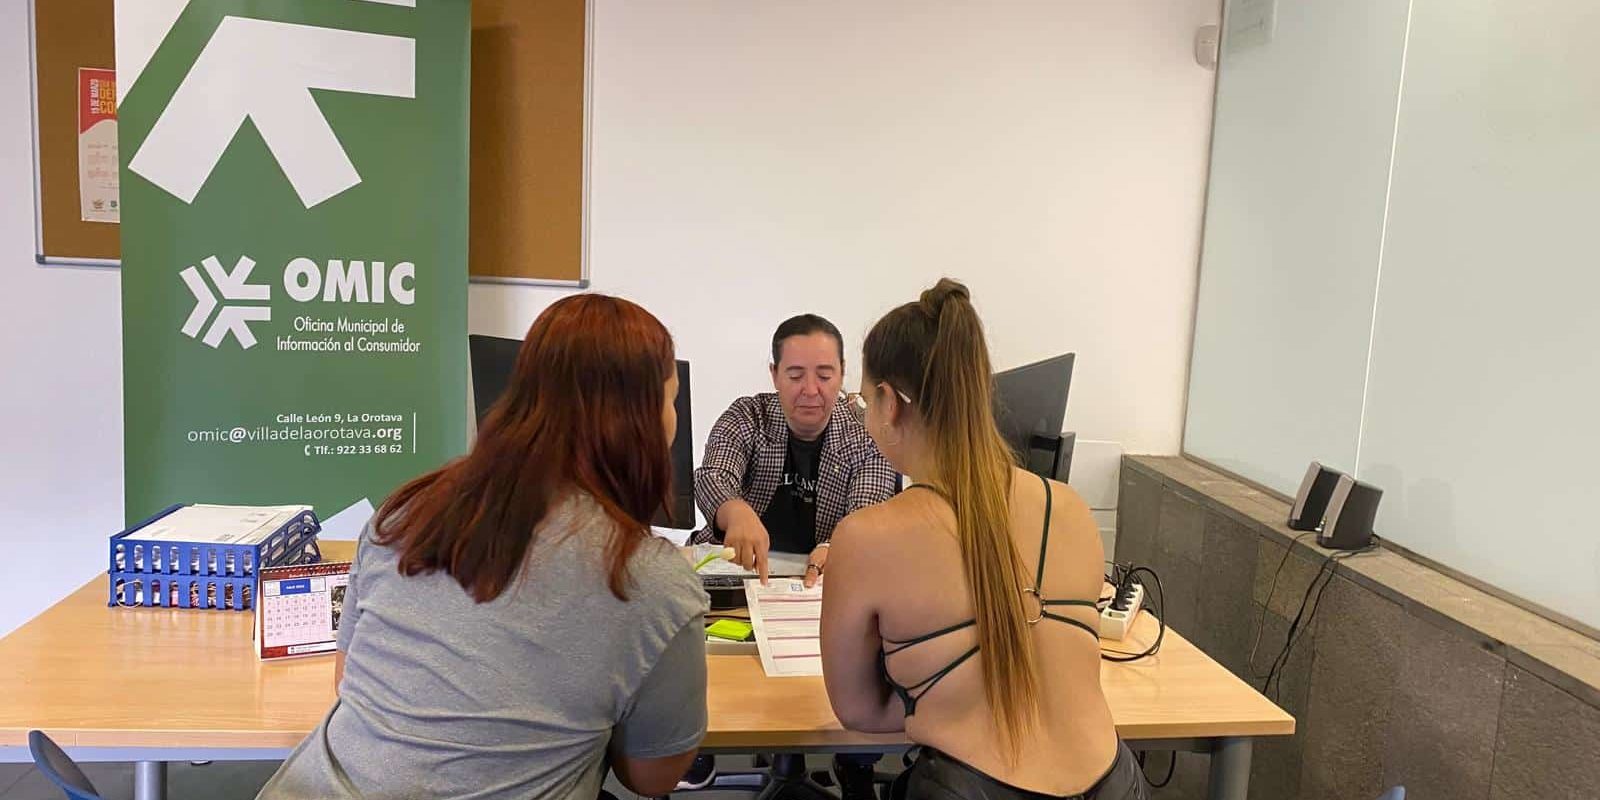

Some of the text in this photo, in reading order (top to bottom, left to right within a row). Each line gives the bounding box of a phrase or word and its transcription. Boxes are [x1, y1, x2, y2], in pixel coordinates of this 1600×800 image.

[283, 257, 415, 305] OMIC
[294, 316, 405, 336] Oficina Municipal de
[277, 336, 420, 352] Información al Consumidor
[276, 413, 403, 425] Calle León 9, La Orotava
[187, 426, 402, 442] omic@villadelaorotava.org
[314, 444, 402, 455] Tlf.: 922 33 68 62
